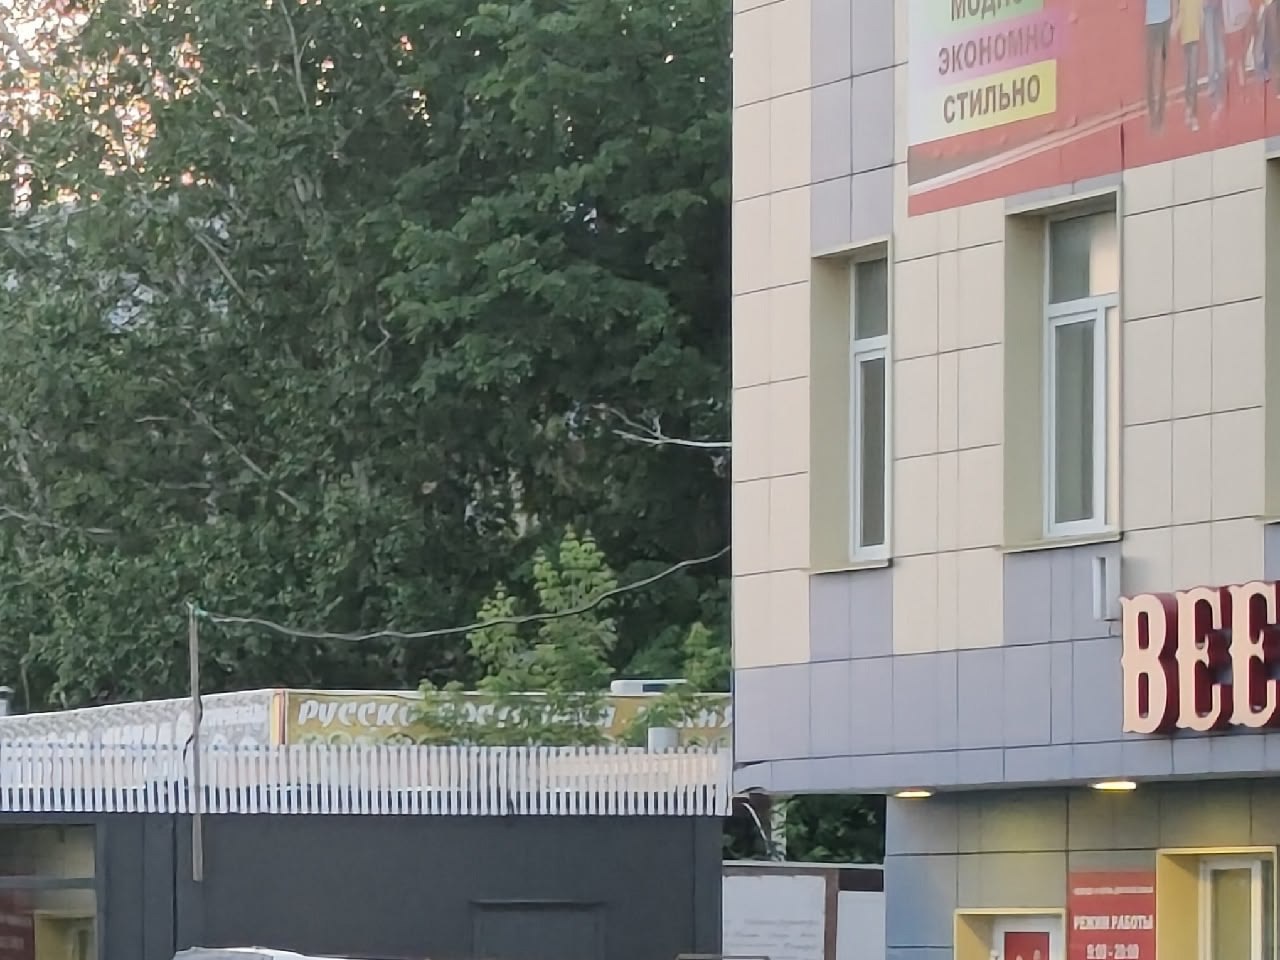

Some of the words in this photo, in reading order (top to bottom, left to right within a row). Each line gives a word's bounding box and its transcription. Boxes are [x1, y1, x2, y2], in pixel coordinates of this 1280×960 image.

[950, 0, 1022, 22] МОД
[937, 23, 1056, 76] ЭКОНОМНО
[943, 74, 1041, 124] СТИЛЬНО
